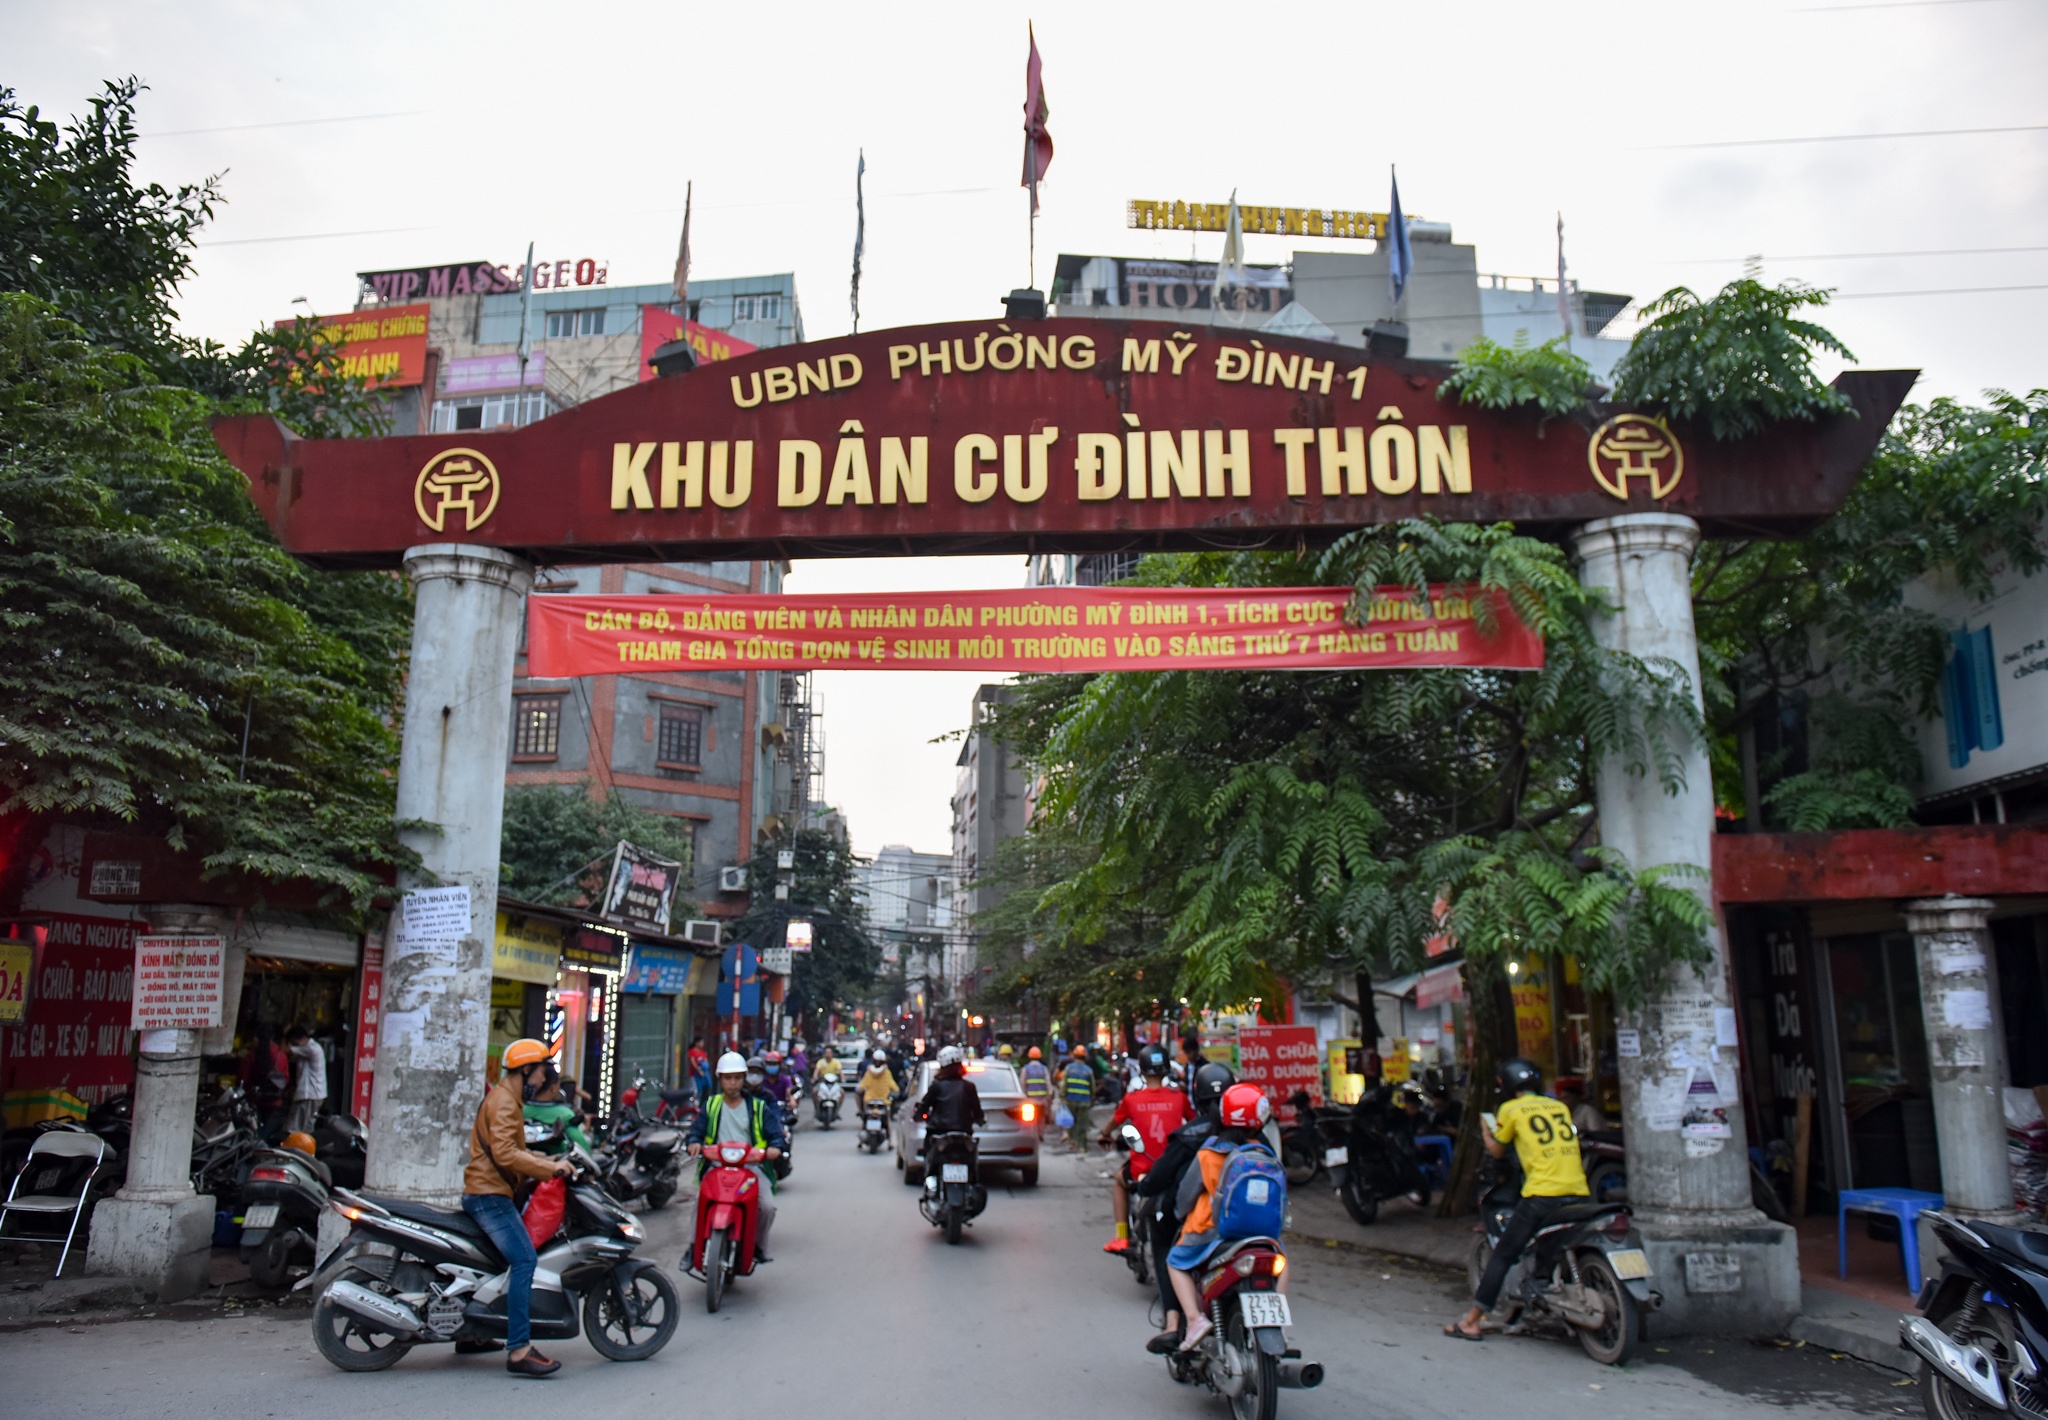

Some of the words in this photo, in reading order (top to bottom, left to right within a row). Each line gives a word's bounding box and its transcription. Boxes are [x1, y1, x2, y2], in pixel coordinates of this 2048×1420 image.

[371, 272, 420, 301] VIP
[333, 348, 400, 381] HÁNH
[730, 353, 865, 409] UBND
[888, 324, 1097, 380] PHƯỜNG
[1121, 331, 1199, 376] MỸ
[1215, 339, 1336, 395] ĐÌNH
[1346, 365, 1368, 401] 1
[610, 440, 754, 510] KHU
[777, 418, 929, 508] DÂN
[953, 426, 1060, 504] CƯ
[1073, 413, 1252, 501] ĐÌNH
[1273, 406, 1474, 497] THÔN
[585, 609, 632, 631] CÁN
[638, 607, 676, 633] BỘ,
[683, 603, 747, 631] ĐẢNG
[753, 606, 807, 630] VIÊN
[813, 605, 844, 629] VÀ
[850, 604, 917, 628] NHÂN
[924, 603, 973, 627] DÂN
[980, 601, 1079, 627] PHƯỜNG
[1085, 602, 1123, 626] MỸ
[1129, 601, 1188, 625] ĐÌNH
[1196, 604, 1218, 626] 1,
[1224, 600, 1279, 624] TÍCH
[1286, 600, 1336, 627] CỰC
[616, 640, 682, 662] THAM
[688, 639, 728, 661] GIA
[733, 633, 794, 660] TỔNG
[801, 640, 850, 664] DỌN
[857, 635, 886, 664] VỆ
[893, 638, 951, 660] SINH
[957, 634, 1004, 659] MÔI
[1011, 632, 1107, 659] TRƯỜNG
[1113, 632, 1162, 658] VÀO
[1168, 632, 1236, 657] SÁNG
[1242, 629, 1293, 656] THỨ
[1295, 634, 1311, 654] 7
[1317, 630, 1387, 654] HÀNG
[141, 952, 160, 967] KÍNH
[83, 957, 108, 1001] BẢO
[55, 1024, 72, 1057] XE
[73, 1011, 89, 1056] SỐ
[1240, 1041, 1270, 1060] SỬA
[1276, 1040, 1319, 1059] CHỮA
[1149, 1113, 1166, 1144] 4
[1528, 1113, 1575, 1145] 93
